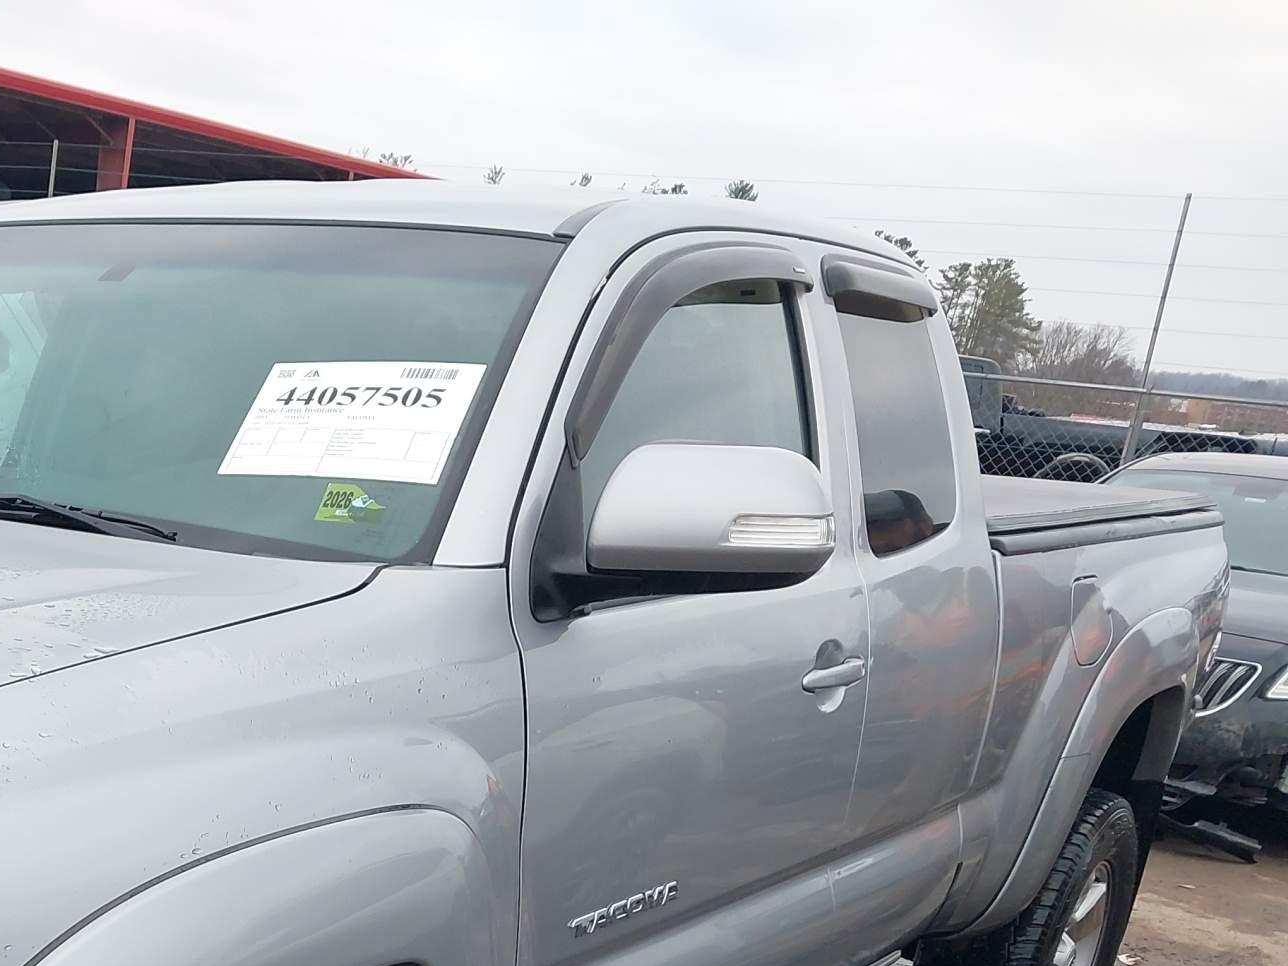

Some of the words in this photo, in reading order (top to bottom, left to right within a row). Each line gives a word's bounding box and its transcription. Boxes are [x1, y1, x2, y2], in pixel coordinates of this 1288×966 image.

[275, 386, 447, 409] 44057505
[322, 490, 354, 509] 2026
[567, 880, 678, 935] TACOMA
